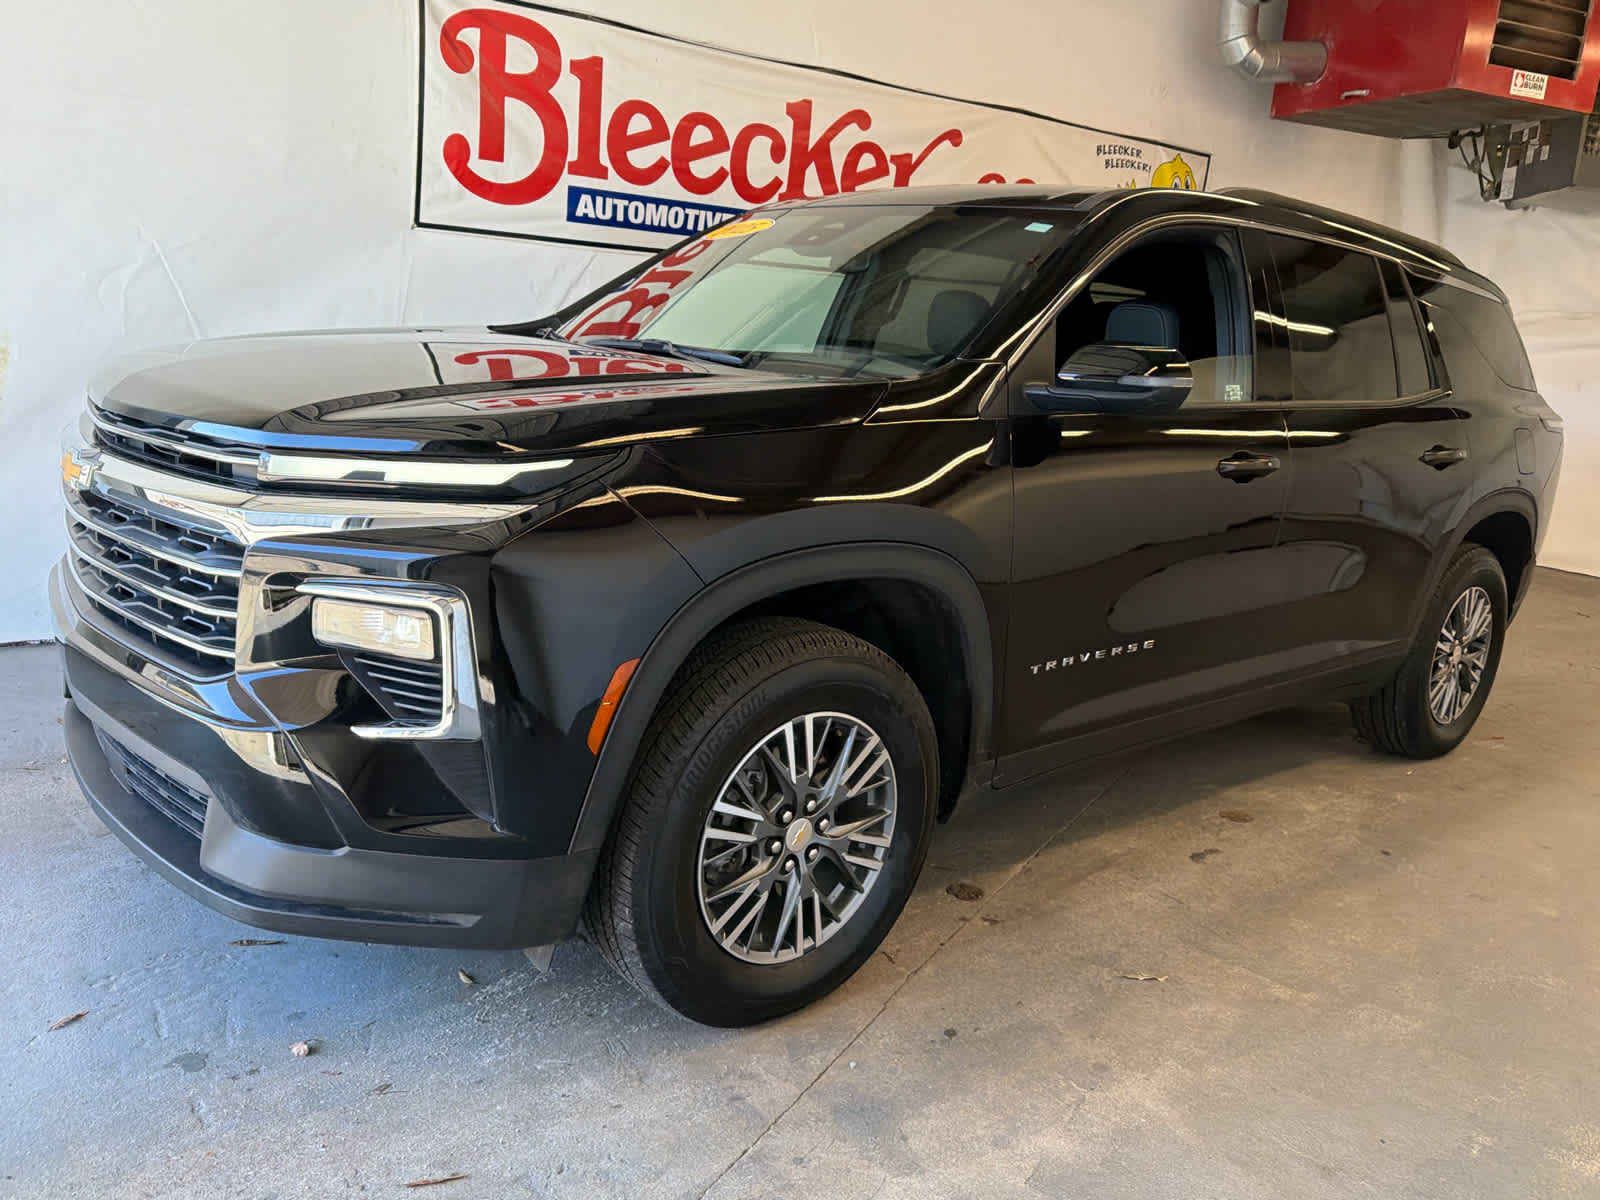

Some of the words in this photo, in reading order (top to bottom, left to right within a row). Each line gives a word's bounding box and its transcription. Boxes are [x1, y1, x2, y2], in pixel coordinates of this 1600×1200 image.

[1525, 73, 1546, 83] CLEAN
[1523, 80, 1544, 92] BURN
[439, 8, 963, 205] Bleecker
[1096, 144, 1143, 159] BLEECKER
[1030, 639, 1156, 675] TRAVERSE
